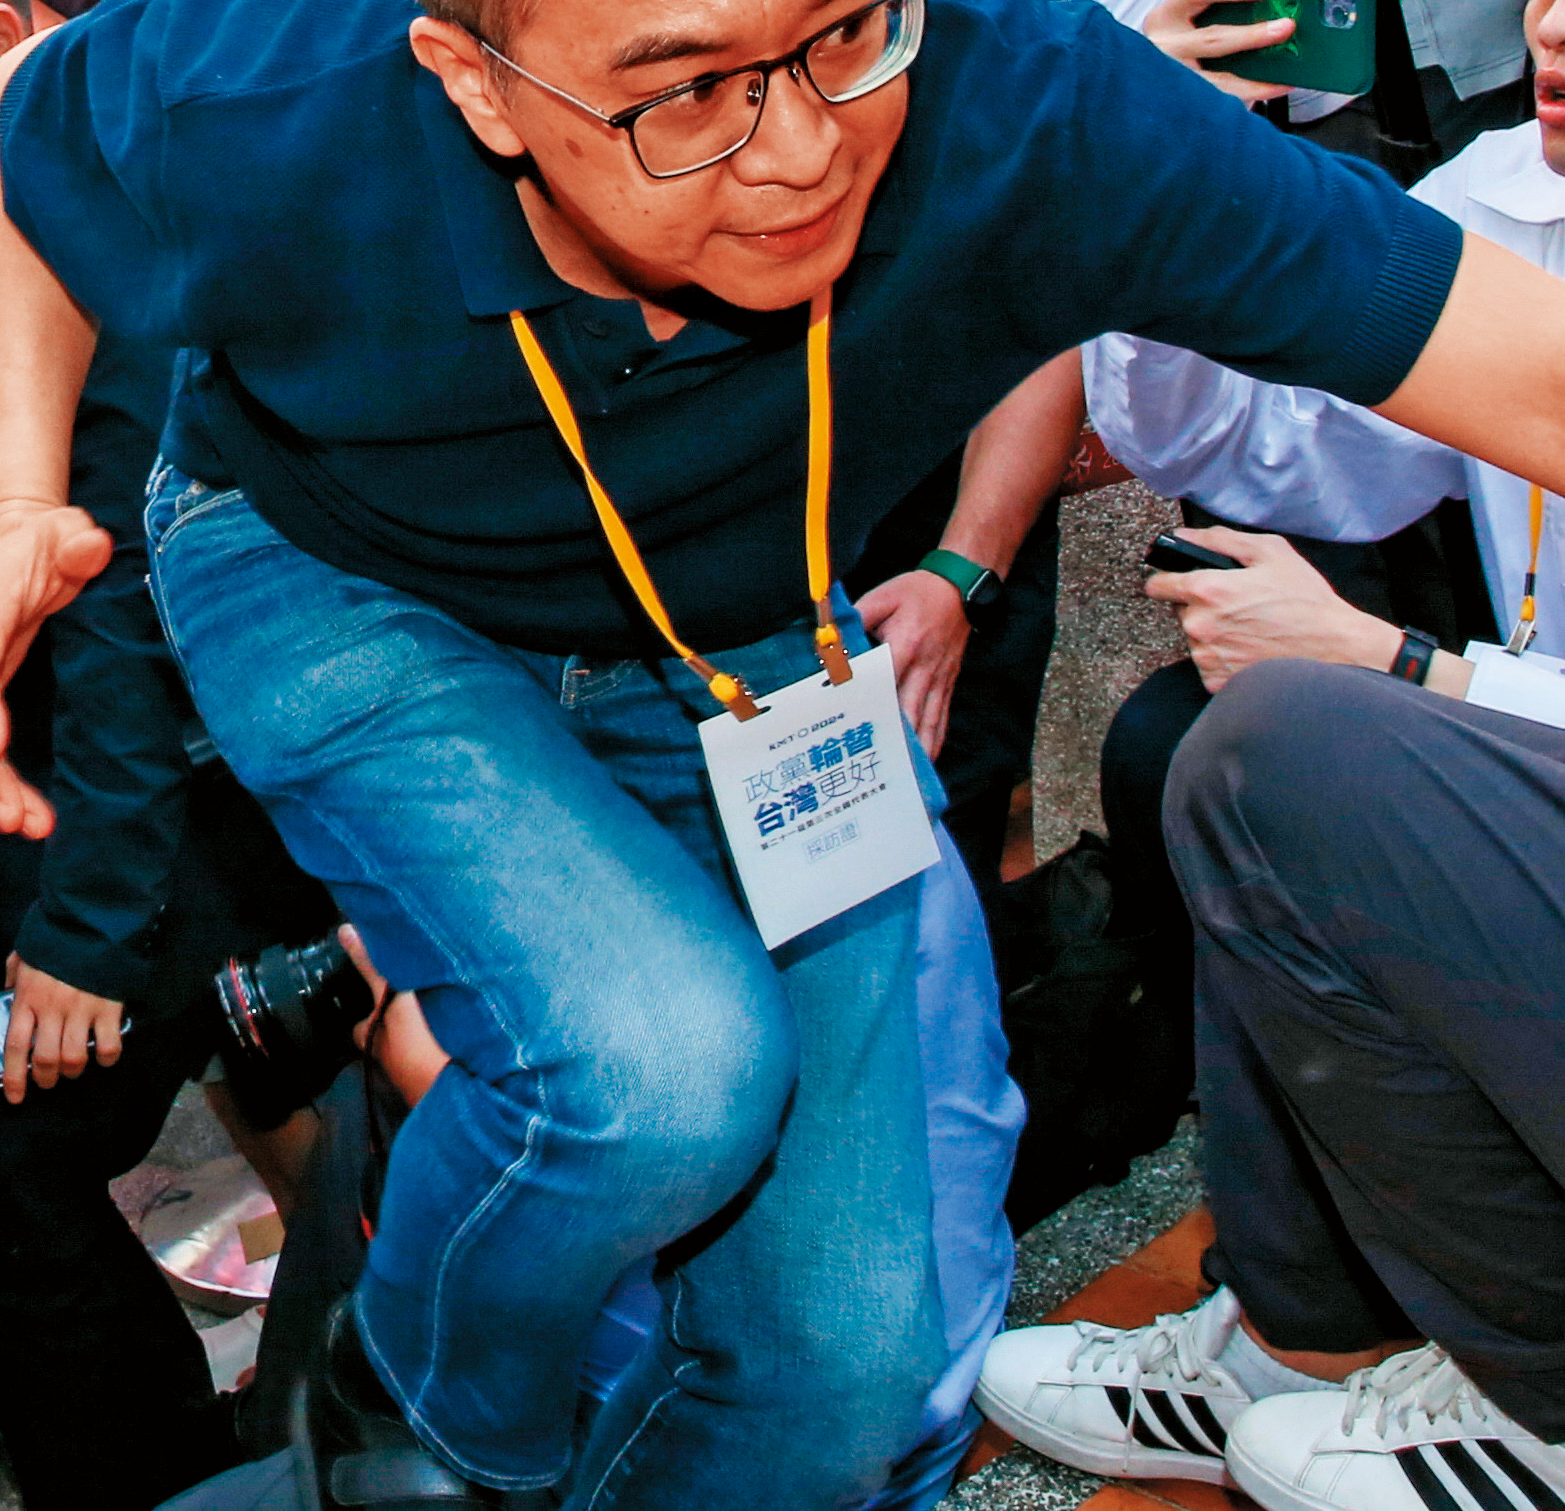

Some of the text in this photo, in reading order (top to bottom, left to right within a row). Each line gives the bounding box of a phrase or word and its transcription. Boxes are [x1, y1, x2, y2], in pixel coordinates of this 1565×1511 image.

[742, 720, 874, 804] 政黨輪替
[810, 712, 846, 733] 2024
[753, 750, 882, 837] 台灣更好
